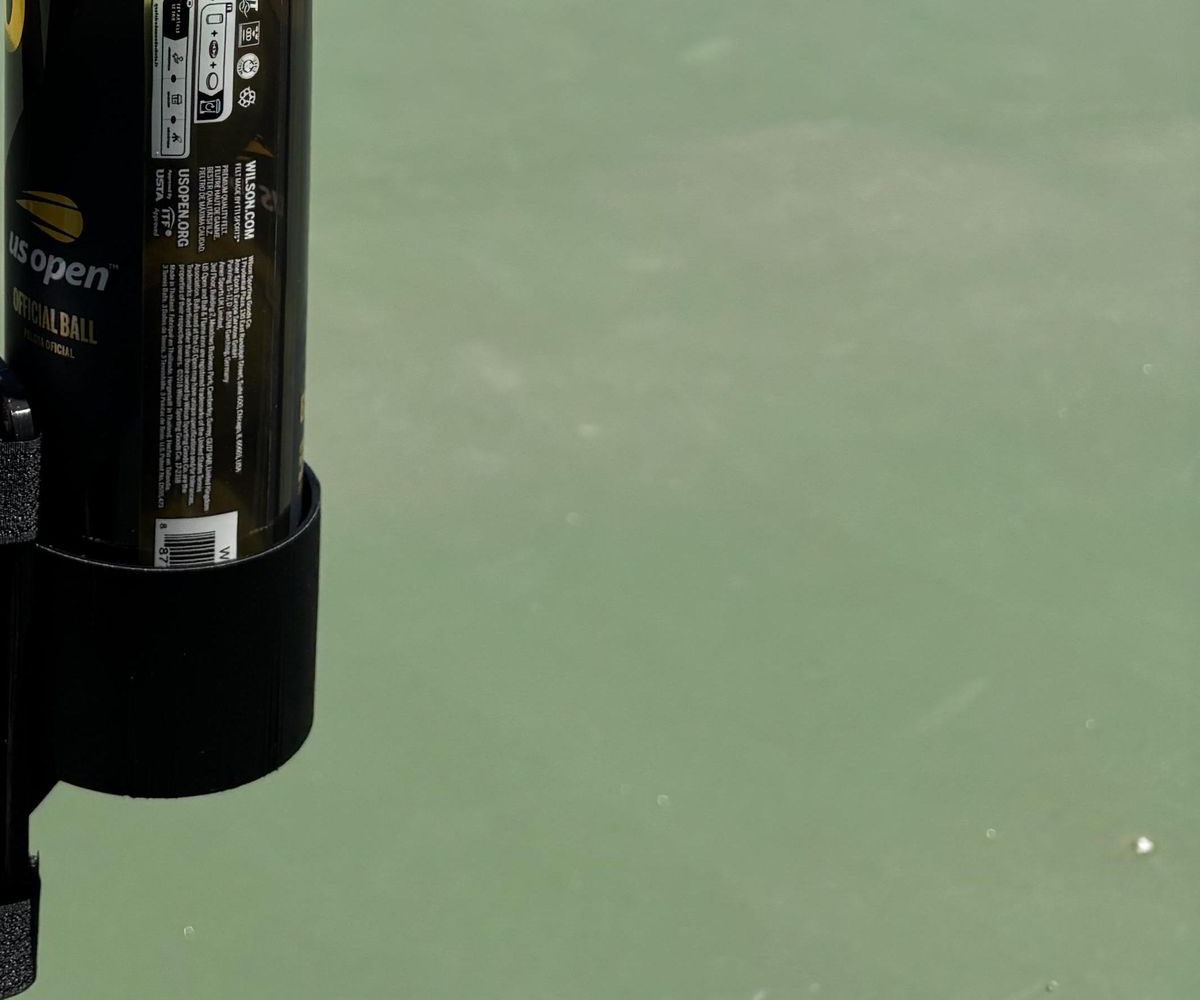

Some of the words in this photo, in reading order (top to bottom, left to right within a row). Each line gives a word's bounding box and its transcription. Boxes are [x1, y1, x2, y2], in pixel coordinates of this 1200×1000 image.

[155, 168, 164, 202] USTA
[198, 192, 205, 200] DE
[177, 168, 190, 247] USOPEN.ORG
[214, 207, 220, 215] DE
[234, 196, 240, 205] BY
[244, 160, 256, 240] WILSON.COM
[152, 208, 160, 237] Approved
[161, 208, 171, 229] ITF
[8, 231, 28, 264] us
[30, 248, 109, 291] open
[12, 287, 58, 334] OFFICIAL
[60, 311, 98, 344] BALL
[45, 339, 75, 359] OFICIAL
